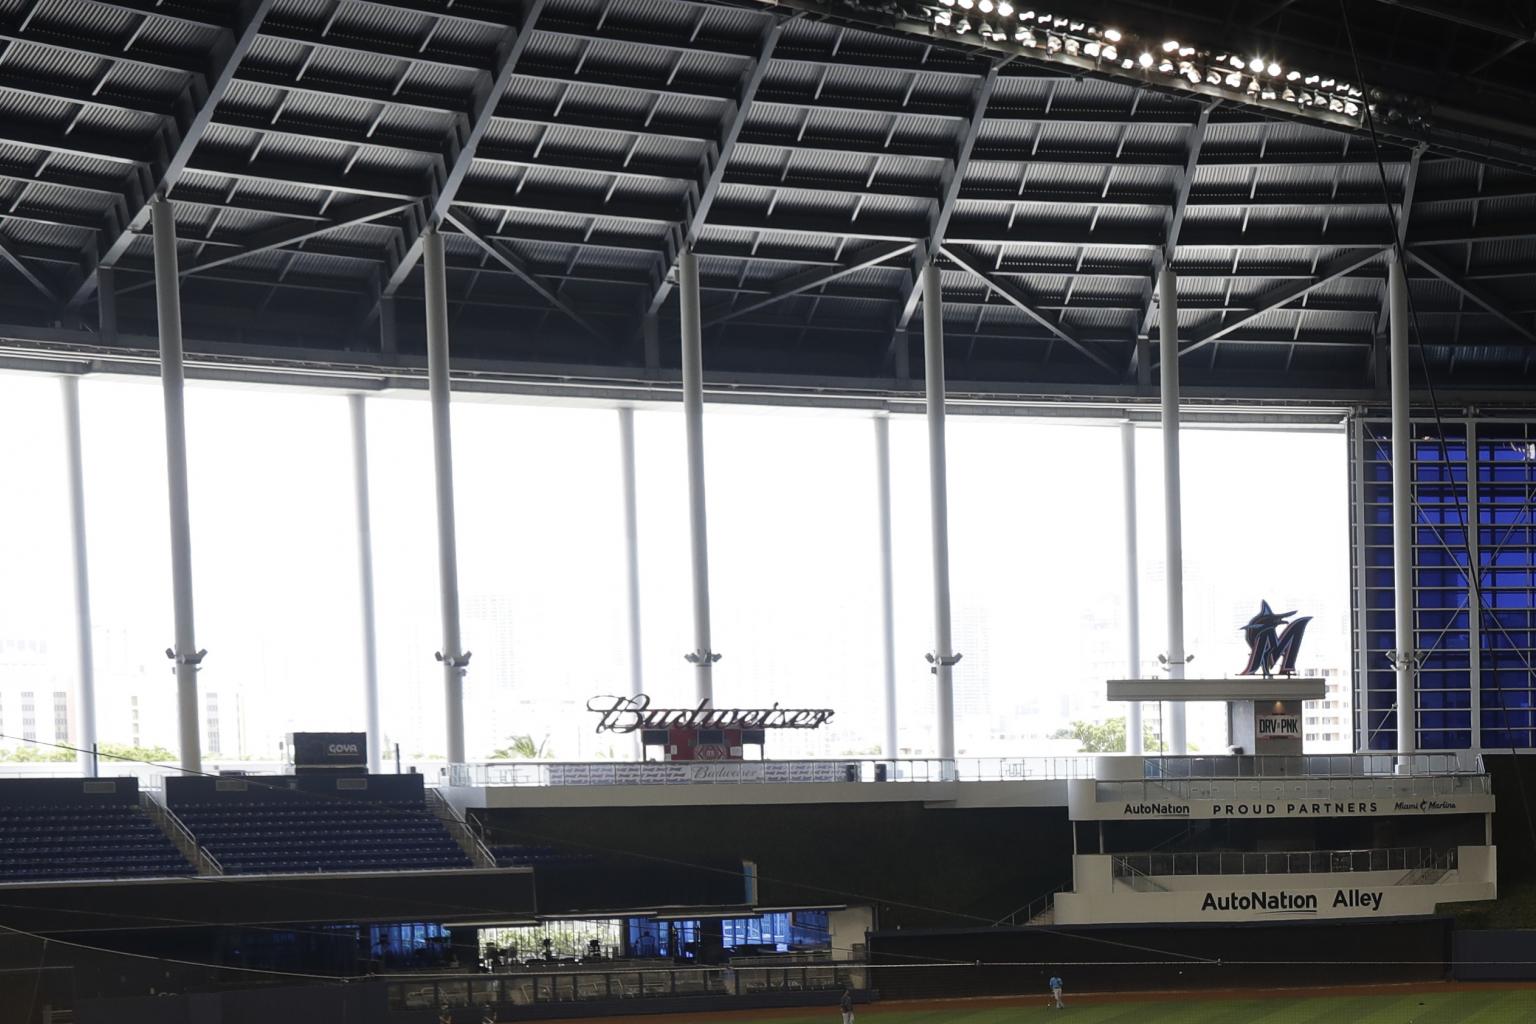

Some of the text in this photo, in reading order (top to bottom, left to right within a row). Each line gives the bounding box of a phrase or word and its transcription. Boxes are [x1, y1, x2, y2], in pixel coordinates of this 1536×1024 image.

[587, 694, 835, 734] Budweiser
[1259, 719, 1298, 733] DRV PNK
[328, 744, 358, 753] GOYA
[1124, 803, 1190, 815] AutoNation
[1213, 802, 1377, 815] PROUD PARTNERS
[1201, 889, 1383, 911] AutoNation Alley
